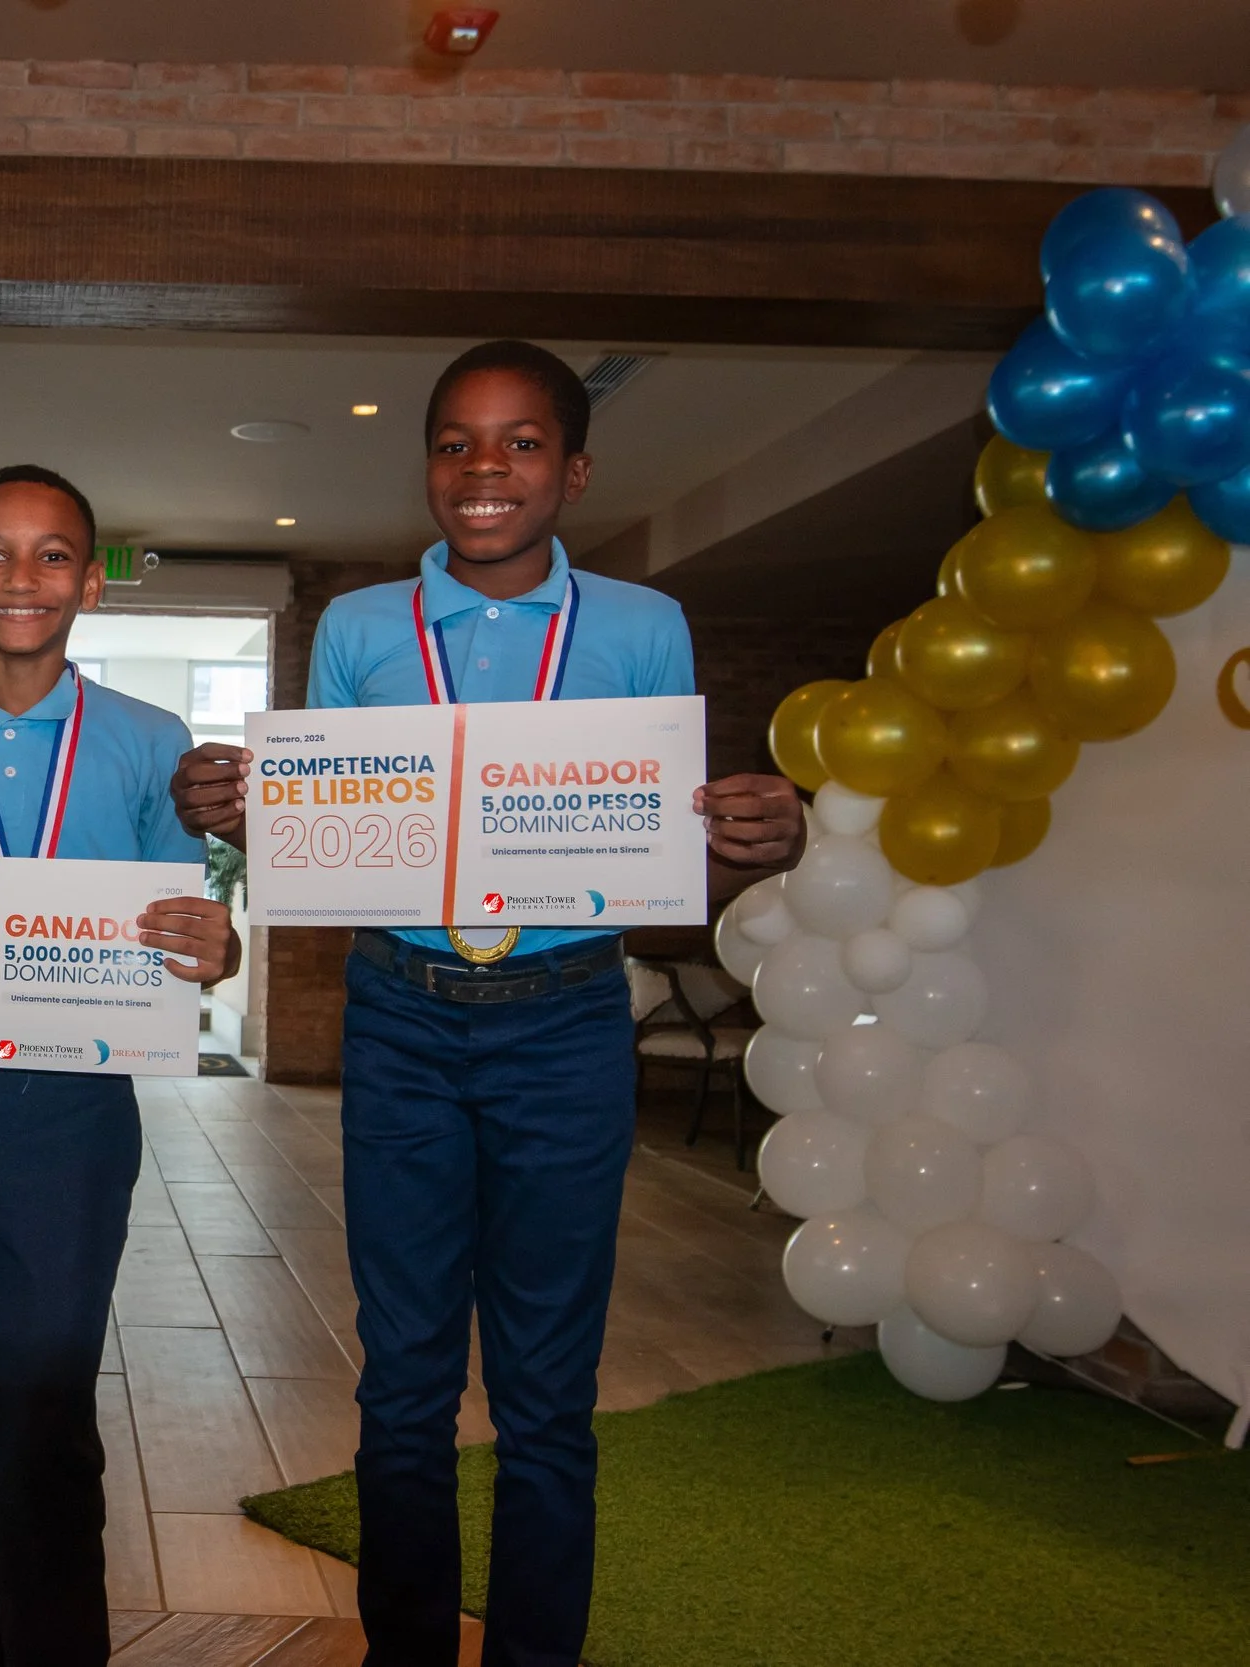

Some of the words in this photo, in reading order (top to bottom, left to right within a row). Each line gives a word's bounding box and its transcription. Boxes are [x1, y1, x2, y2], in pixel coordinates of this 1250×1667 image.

[260, 755, 435, 777] COMPETENCIA
[481, 760, 661, 787] GANADOR
[262, 780, 303, 806] DE
[313, 777, 435, 805] LIBROS
[481, 793, 581, 815] 5,000.00
[588, 793, 661, 810] PESOS
[482, 813, 661, 834] DOMINICANOS
[271, 814, 437, 868] 2026
[492, 848, 547, 856] Unicamente
[549, 847, 594, 856] canjeable
[507, 896, 544, 904] PHOENIX
[546, 896, 576, 904] TOWER
[647, 897, 684, 910] project
[5, 914, 141, 942] GANADO
[4, 944, 93, 963] 5,000.00
[99, 948, 164, 966] PESOS
[4, 963, 162, 987] DOMINICANOS
[11, 995, 60, 1004] Unicamente
[62, 997, 102, 1006] canjeable
[19, 1044, 54, 1053] PHOENIX
[55, 1045, 83, 1054] TOWER
[112, 1049, 145, 1057] DREAM
[147, 1049, 180, 1061] project
